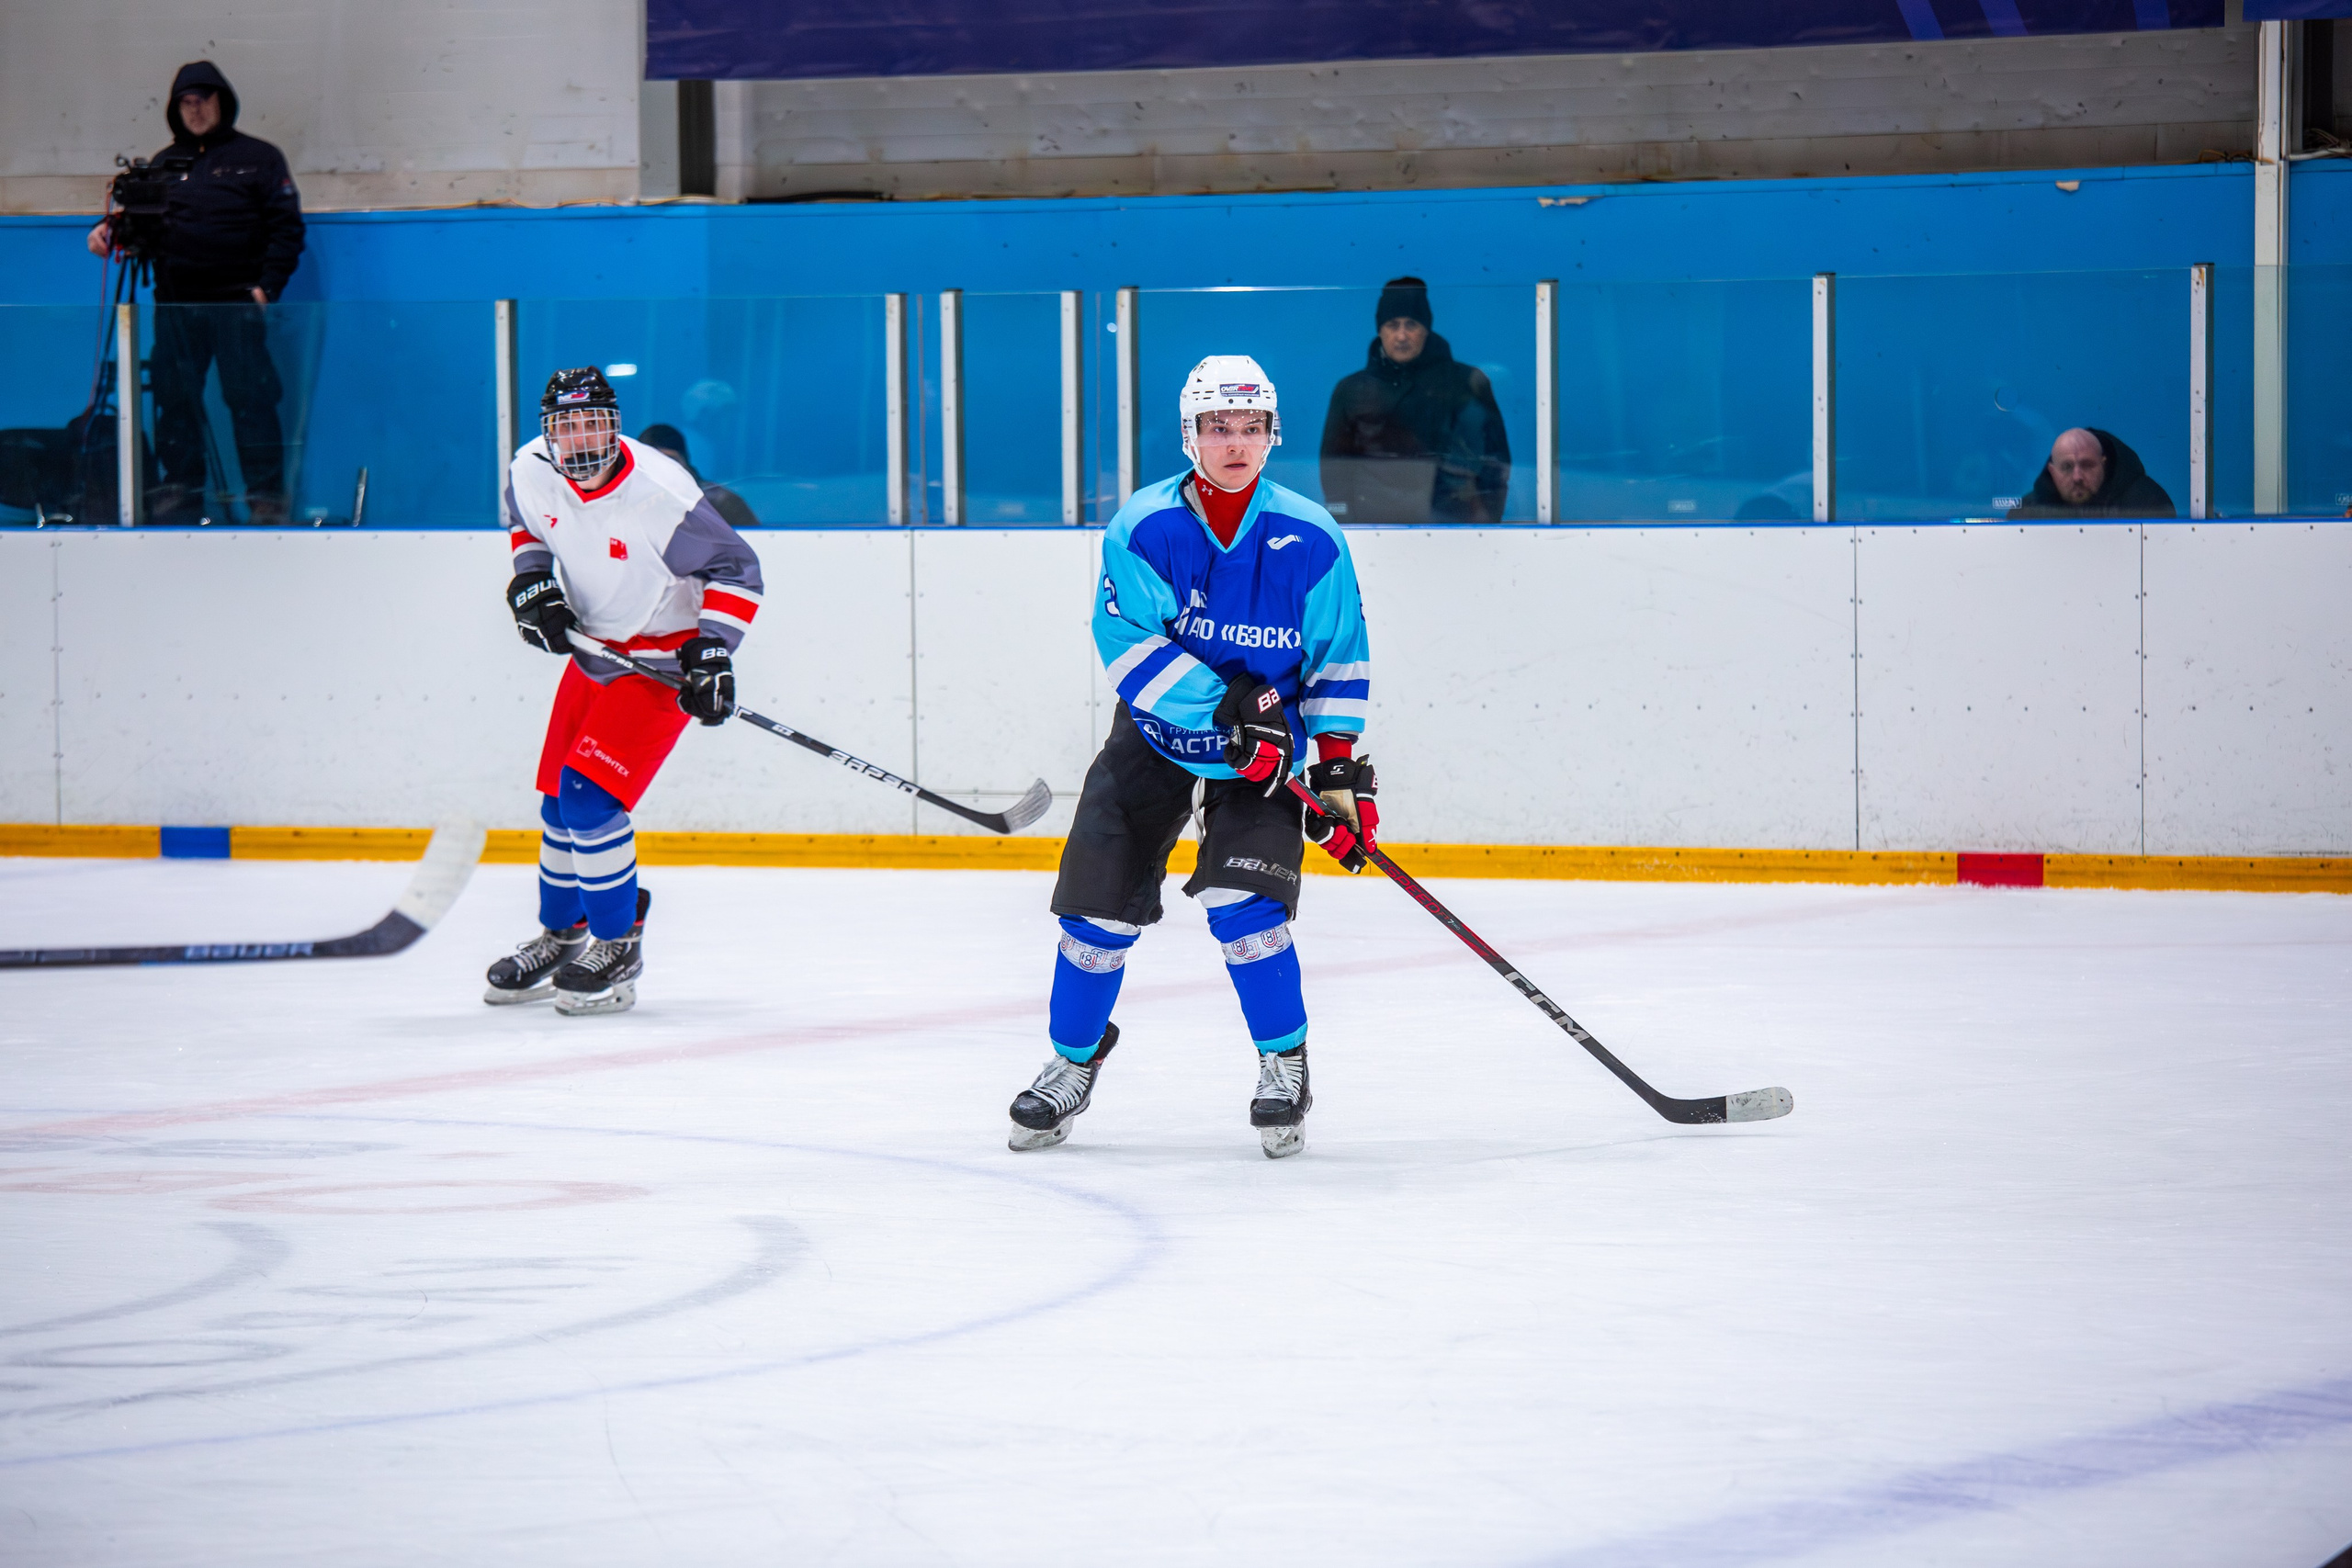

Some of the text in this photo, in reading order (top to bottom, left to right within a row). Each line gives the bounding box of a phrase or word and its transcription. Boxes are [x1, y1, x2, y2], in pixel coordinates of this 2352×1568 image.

[1170, 735, 1230, 754] АСТР
[1374, 852, 1441, 914] TSPEED
[1505, 971, 1591, 1043] CCM
